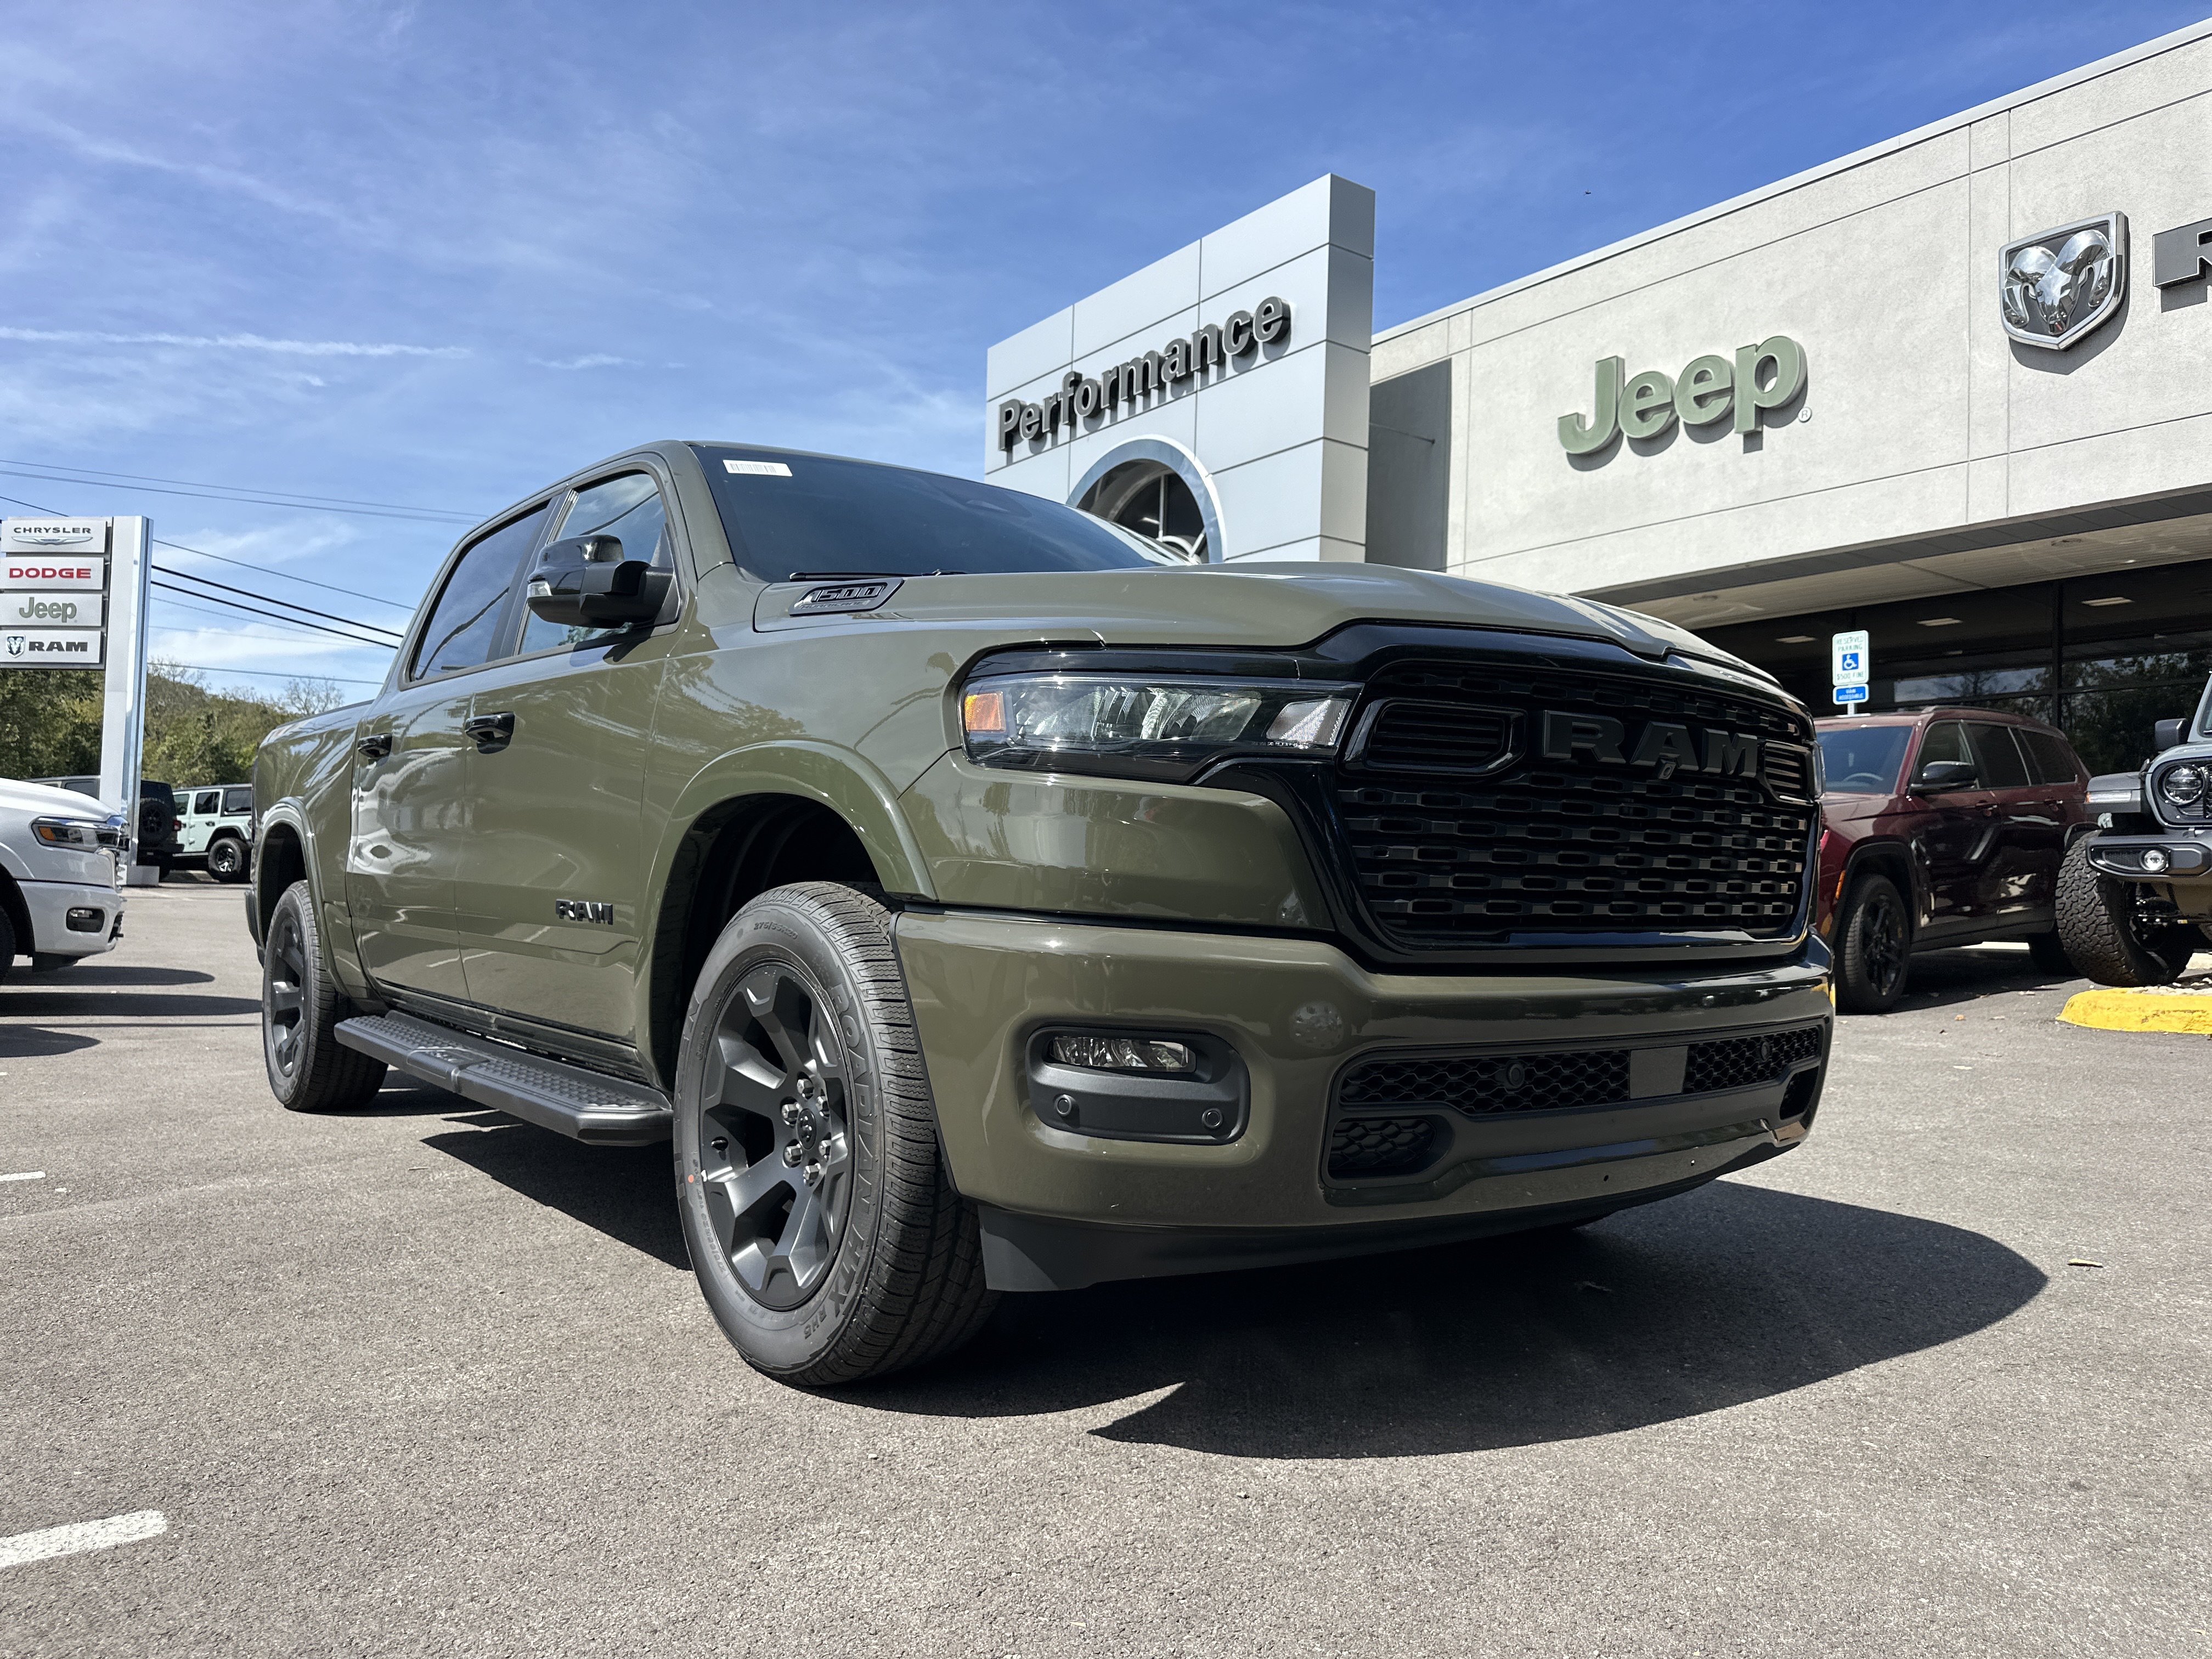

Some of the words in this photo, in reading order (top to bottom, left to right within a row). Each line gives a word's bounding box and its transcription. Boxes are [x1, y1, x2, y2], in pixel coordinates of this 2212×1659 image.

[998, 295, 1291, 452] Performance
[1557, 335, 1805, 454] Jeep
[9, 568, 92, 579] DODGE
[808, 585, 883, 602] 1500
[19, 597, 77, 623] Jeep
[29, 641, 88, 652] RAM
[1837, 636, 1864, 645] RESERVED
[1542, 709, 1758, 778] RAM
[555, 898, 613, 925] RAM
